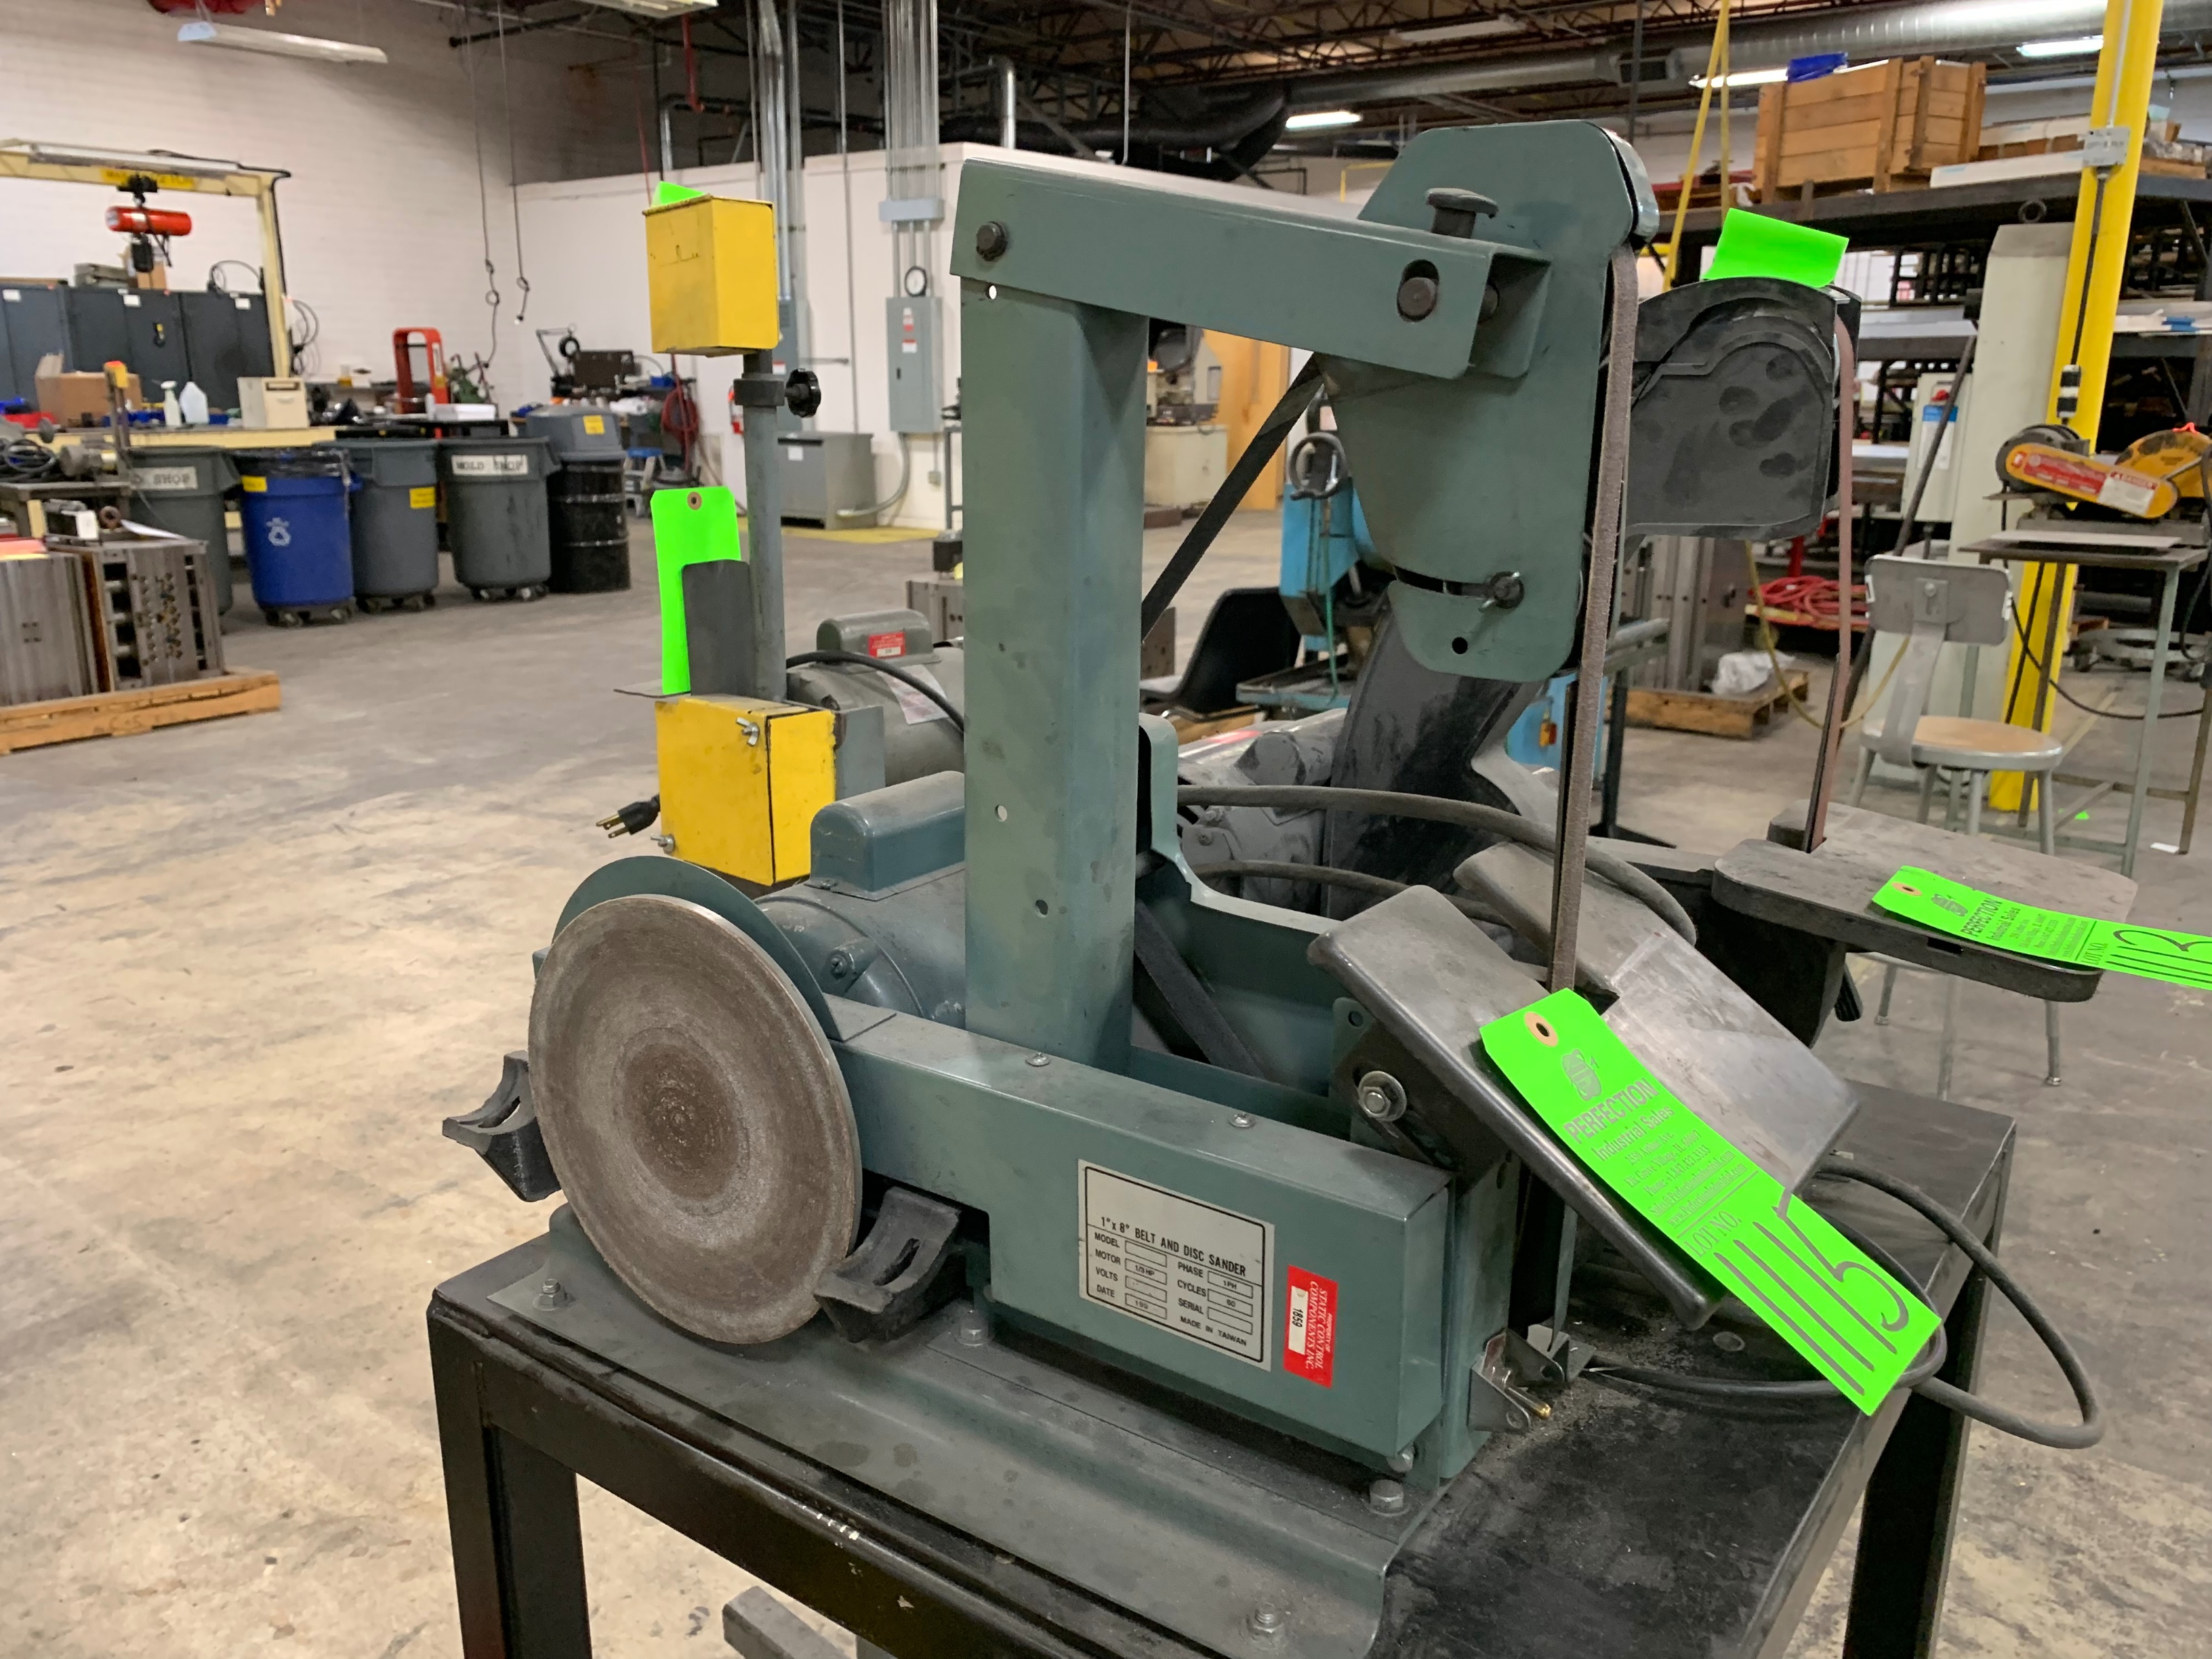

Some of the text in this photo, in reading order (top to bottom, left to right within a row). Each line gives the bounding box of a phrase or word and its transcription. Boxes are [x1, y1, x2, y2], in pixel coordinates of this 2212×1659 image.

[1961, 898, 2003, 937] PERFECTION
[2001, 907, 2020, 921] Sales
[2081, 951, 2103, 964] LOT
[1563, 1078, 1659, 1144] PERFECTION
[1591, 1106, 1675, 1161] Industrial Sales
[1094, 1232, 1120, 1248] MODEL
[1684, 1211, 1742, 1257] LOT NO.
[1095, 1249, 1121, 1265] MOTOR
[1135, 1227, 1156, 1244] BELT
[1161, 1236, 1179, 1252] AND
[1184, 1244, 1204, 1261] DISC
[1209, 1254, 1246, 1276] SANDER
[1095, 1266, 1118, 1282] VOLTS
[1178, 1262, 1204, 1277] PHASE
[1097, 1284, 1115, 1298] DATE
[1177, 1279, 1206, 1297] CYCLES
[1179, 1298, 1204, 1315] SERIAL
[1292, 1308, 1303, 1328] 1859
[1305, 1281, 1318, 1369] COMPONENTS INC.
[1180, 1316, 1202, 1330] MADE
[1218, 1330, 1247, 1347] TAIWAN
[1315, 1288, 1327, 1369] STATIC CONTROL
[1325, 1344, 1330, 1353] OF
